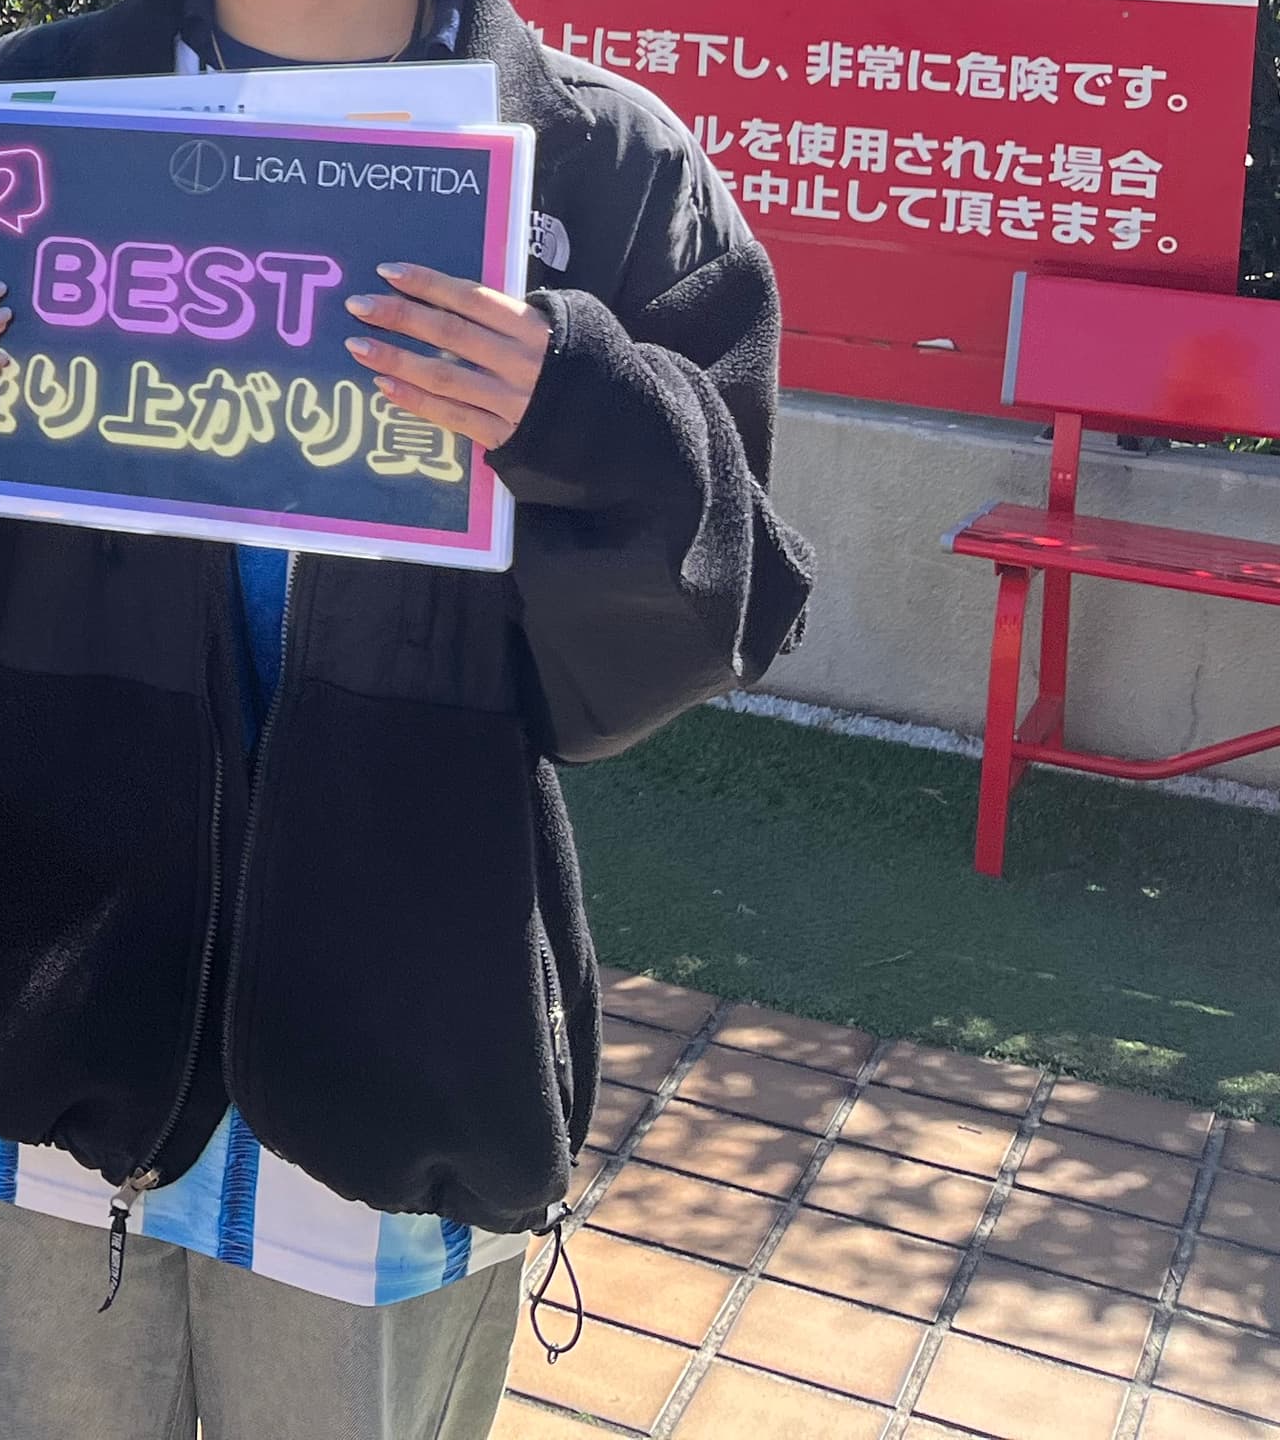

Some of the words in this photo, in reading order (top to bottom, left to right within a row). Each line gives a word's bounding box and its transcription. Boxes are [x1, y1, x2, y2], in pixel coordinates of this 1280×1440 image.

[527, 20, 1189, 113] 上に落下し、非常に危険です。
[692, 115, 1162, 200] ルを使用された場合
[32, 236, 343, 348] BEST
